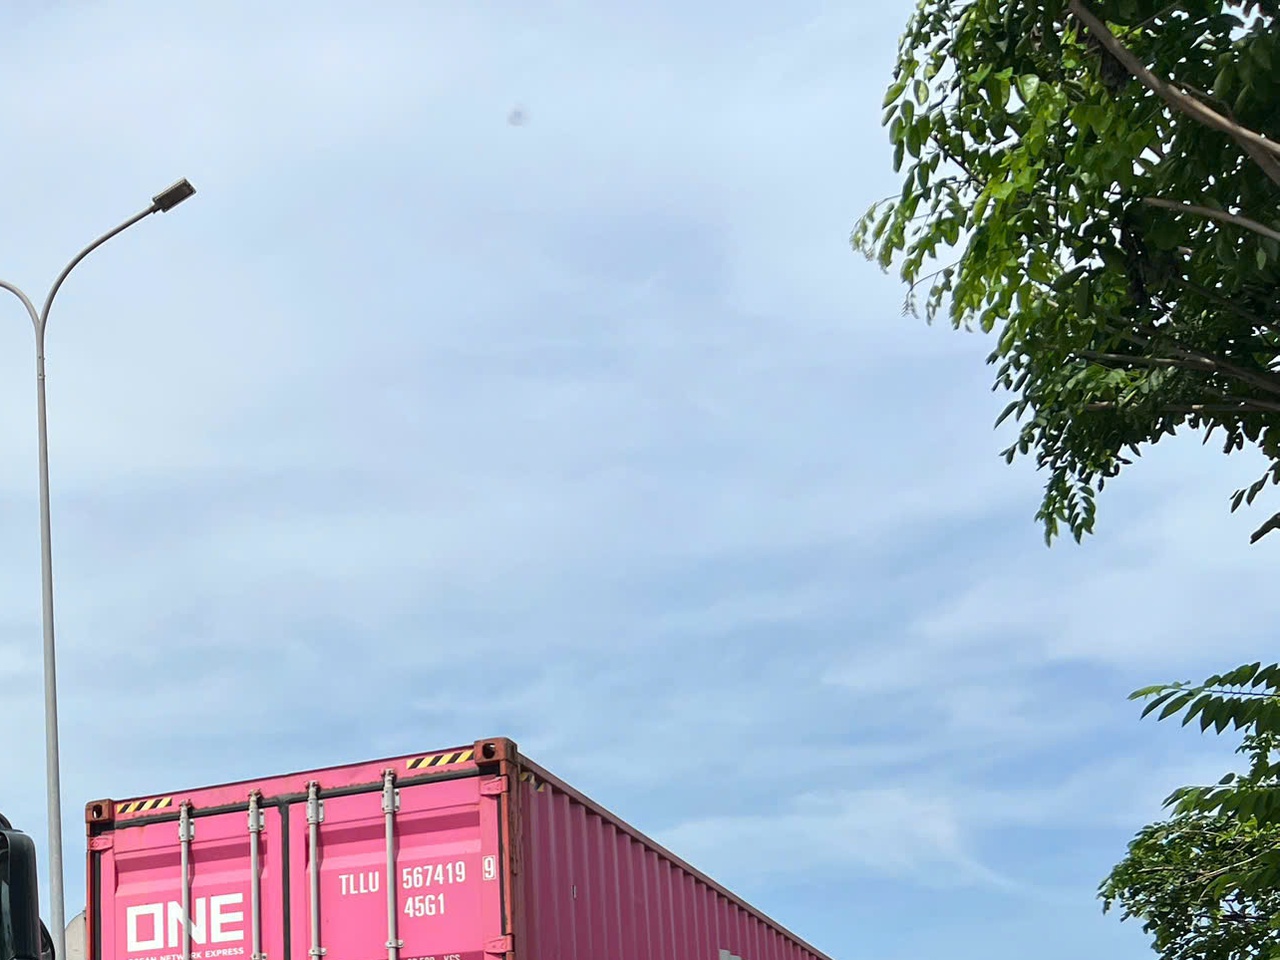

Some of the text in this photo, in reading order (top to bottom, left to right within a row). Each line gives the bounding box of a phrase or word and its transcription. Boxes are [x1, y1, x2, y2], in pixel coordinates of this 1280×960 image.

[339, 856, 495, 895] TLLU 567419 9
[404, 893, 445, 918] 45G1
[126, 892, 244, 952] ONE
[205, 947, 244, 958] EXPRESS
